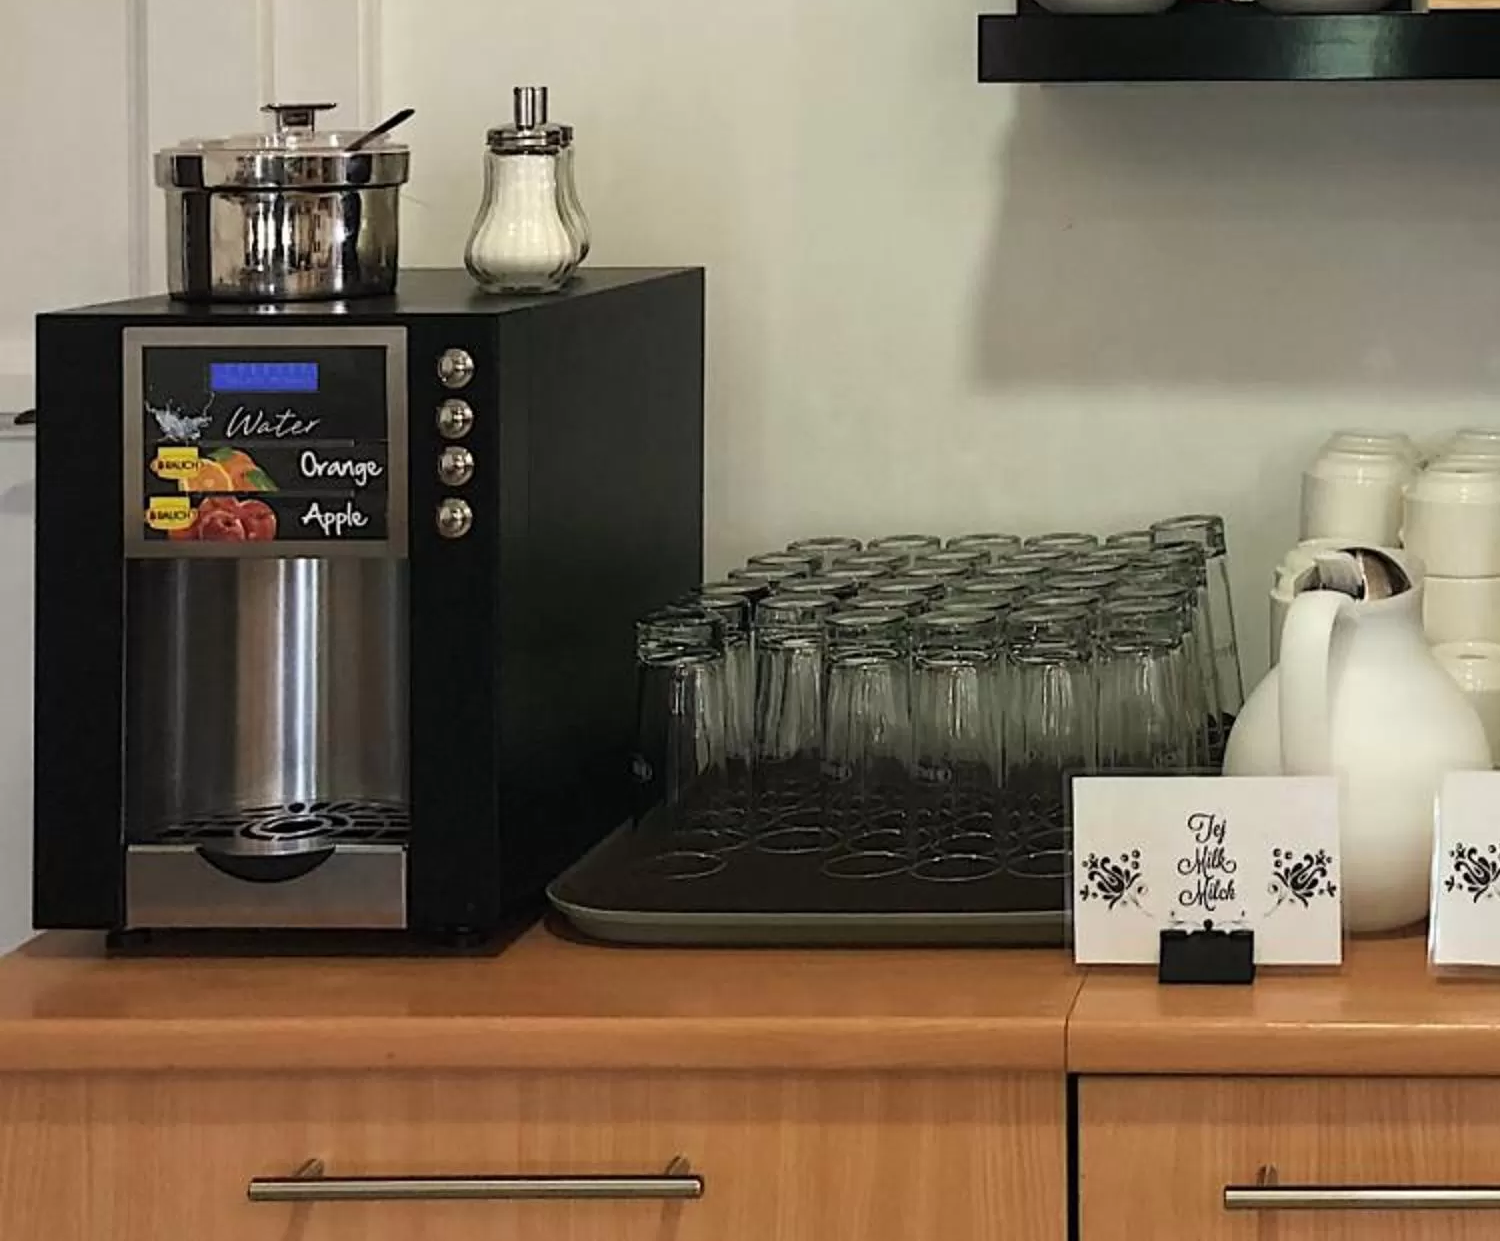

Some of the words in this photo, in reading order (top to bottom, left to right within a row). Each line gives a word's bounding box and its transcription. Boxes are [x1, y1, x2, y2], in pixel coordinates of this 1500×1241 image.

[225, 406, 321, 439] Water
[301, 450, 384, 487] Orange
[301, 502, 369, 536] Apple
[1187, 812, 1227, 845] Tej
[1177, 845, 1237, 880] Milk
[1178, 878, 1235, 912] Milch
